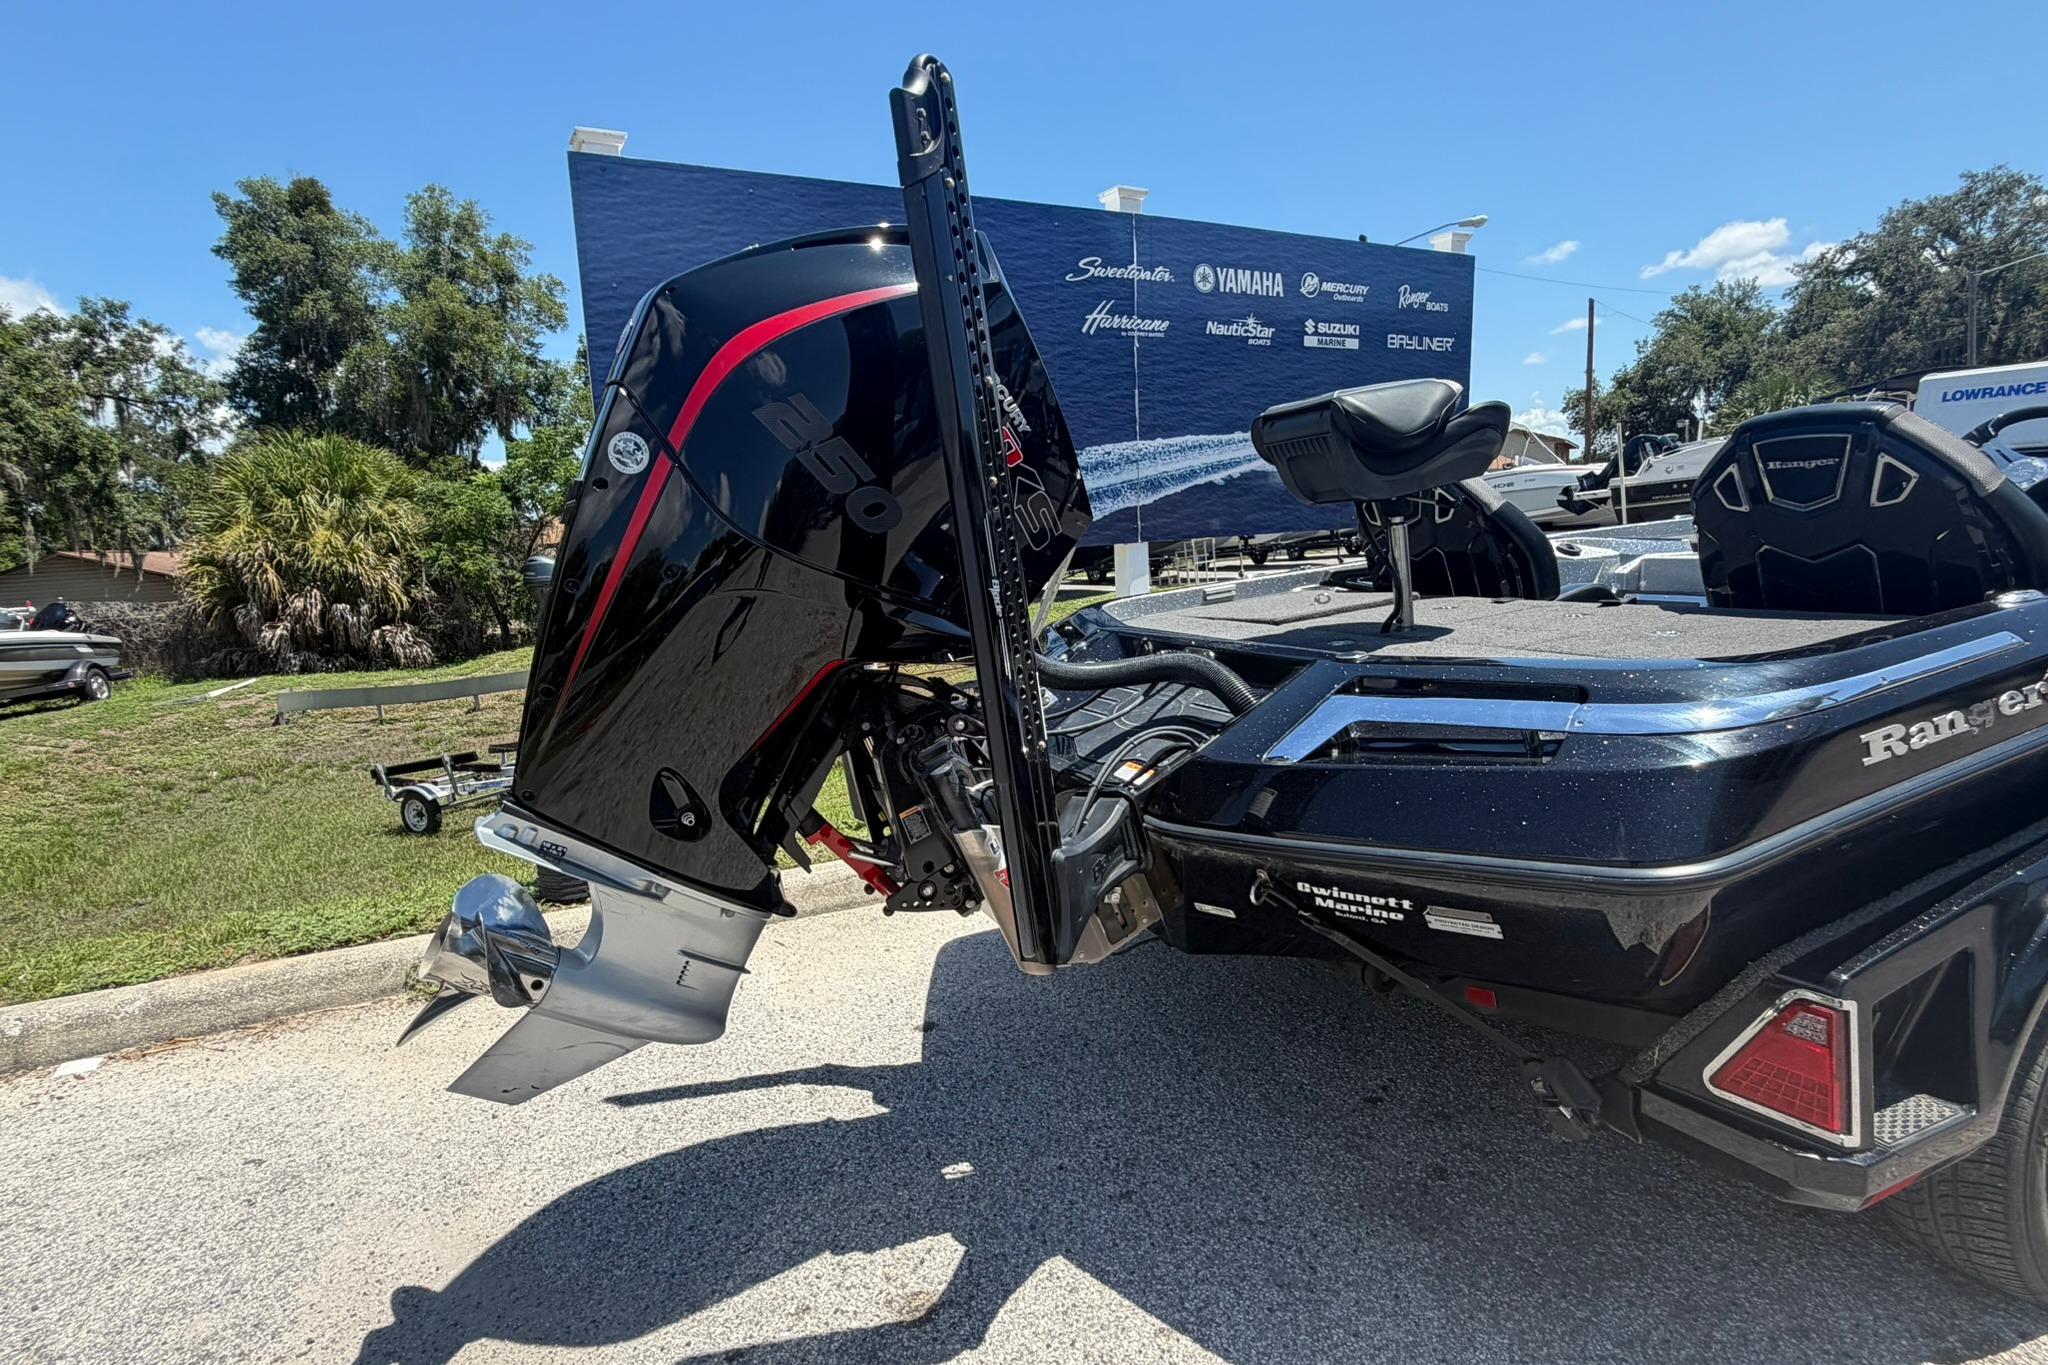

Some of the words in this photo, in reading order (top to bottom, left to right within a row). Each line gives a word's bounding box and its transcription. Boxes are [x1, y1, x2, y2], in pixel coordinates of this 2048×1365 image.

[1065, 256, 1173, 282] Sweetwater
[1216, 267, 1284, 297] YAMAHA
[1321, 281, 1369, 295] MERCURY
[1333, 293, 1364, 303] Outboards
[1398, 284, 1430, 309] Ranger
[1425, 301, 1449, 312] BOATS
[1081, 299, 1170, 335] Hurricane
[1205, 317, 1275, 338] NauticStar
[1317, 322, 1359, 335] SUZUKI
[1248, 338, 1271, 346] BOATS
[1316, 337, 1348, 348] MARINE
[1387, 334, 1453, 351] BAYLINER
[1941, 381, 2048, 403] LOWRANCE
[752, 392, 903, 534] 250
[1767, 458, 1839, 469] Ranger
[1860, 680, 2048, 767] Ranger
[1297, 882, 1414, 911] Gwinnett
[1315, 896, 1404, 921] Marine
